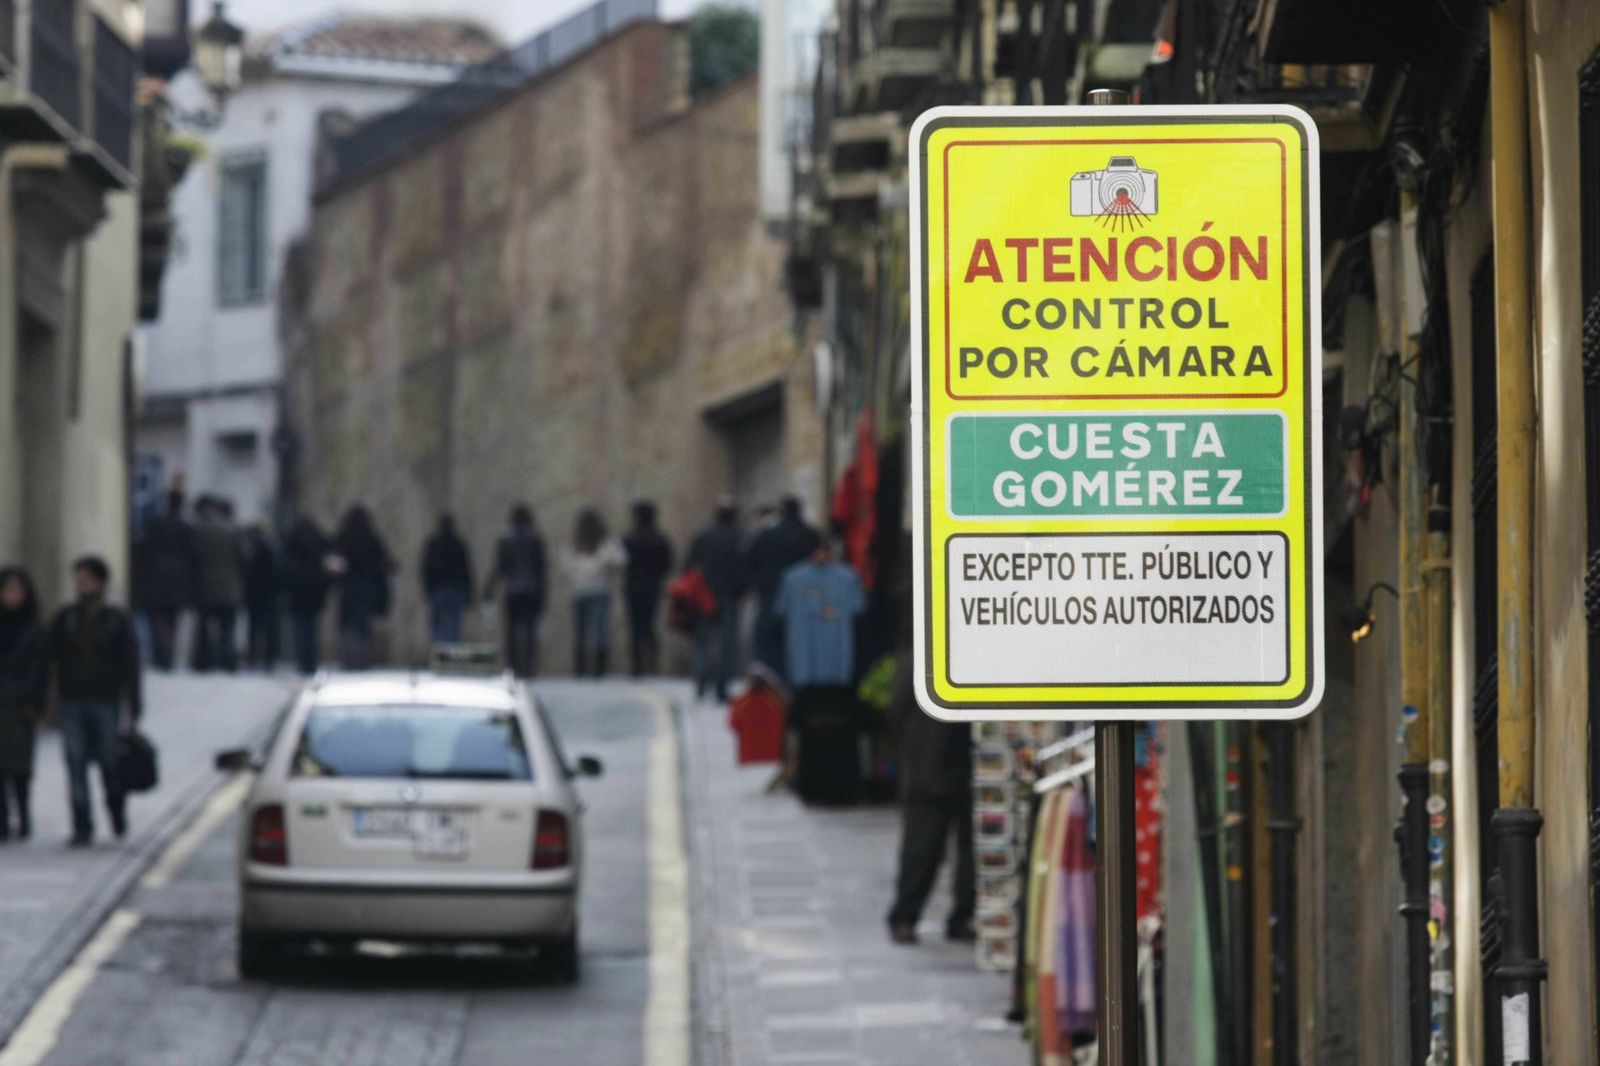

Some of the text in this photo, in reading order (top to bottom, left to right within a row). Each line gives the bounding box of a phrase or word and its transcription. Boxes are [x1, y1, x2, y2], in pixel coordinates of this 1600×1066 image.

[964, 221, 1268, 283] ATENCIÓN
[1002, 297, 1230, 330] CONTROL
[960, 339, 1273, 379] POR CÁMARA
[1009, 422, 1226, 459] CUESTA
[993, 462, 1244, 507] GOMÉREZ
[963, 544, 1274, 581] EXCEPTO TTE. PÚBLICO Y
[961, 591, 1274, 626] VEHÍCULOS AUTORIZADOS
